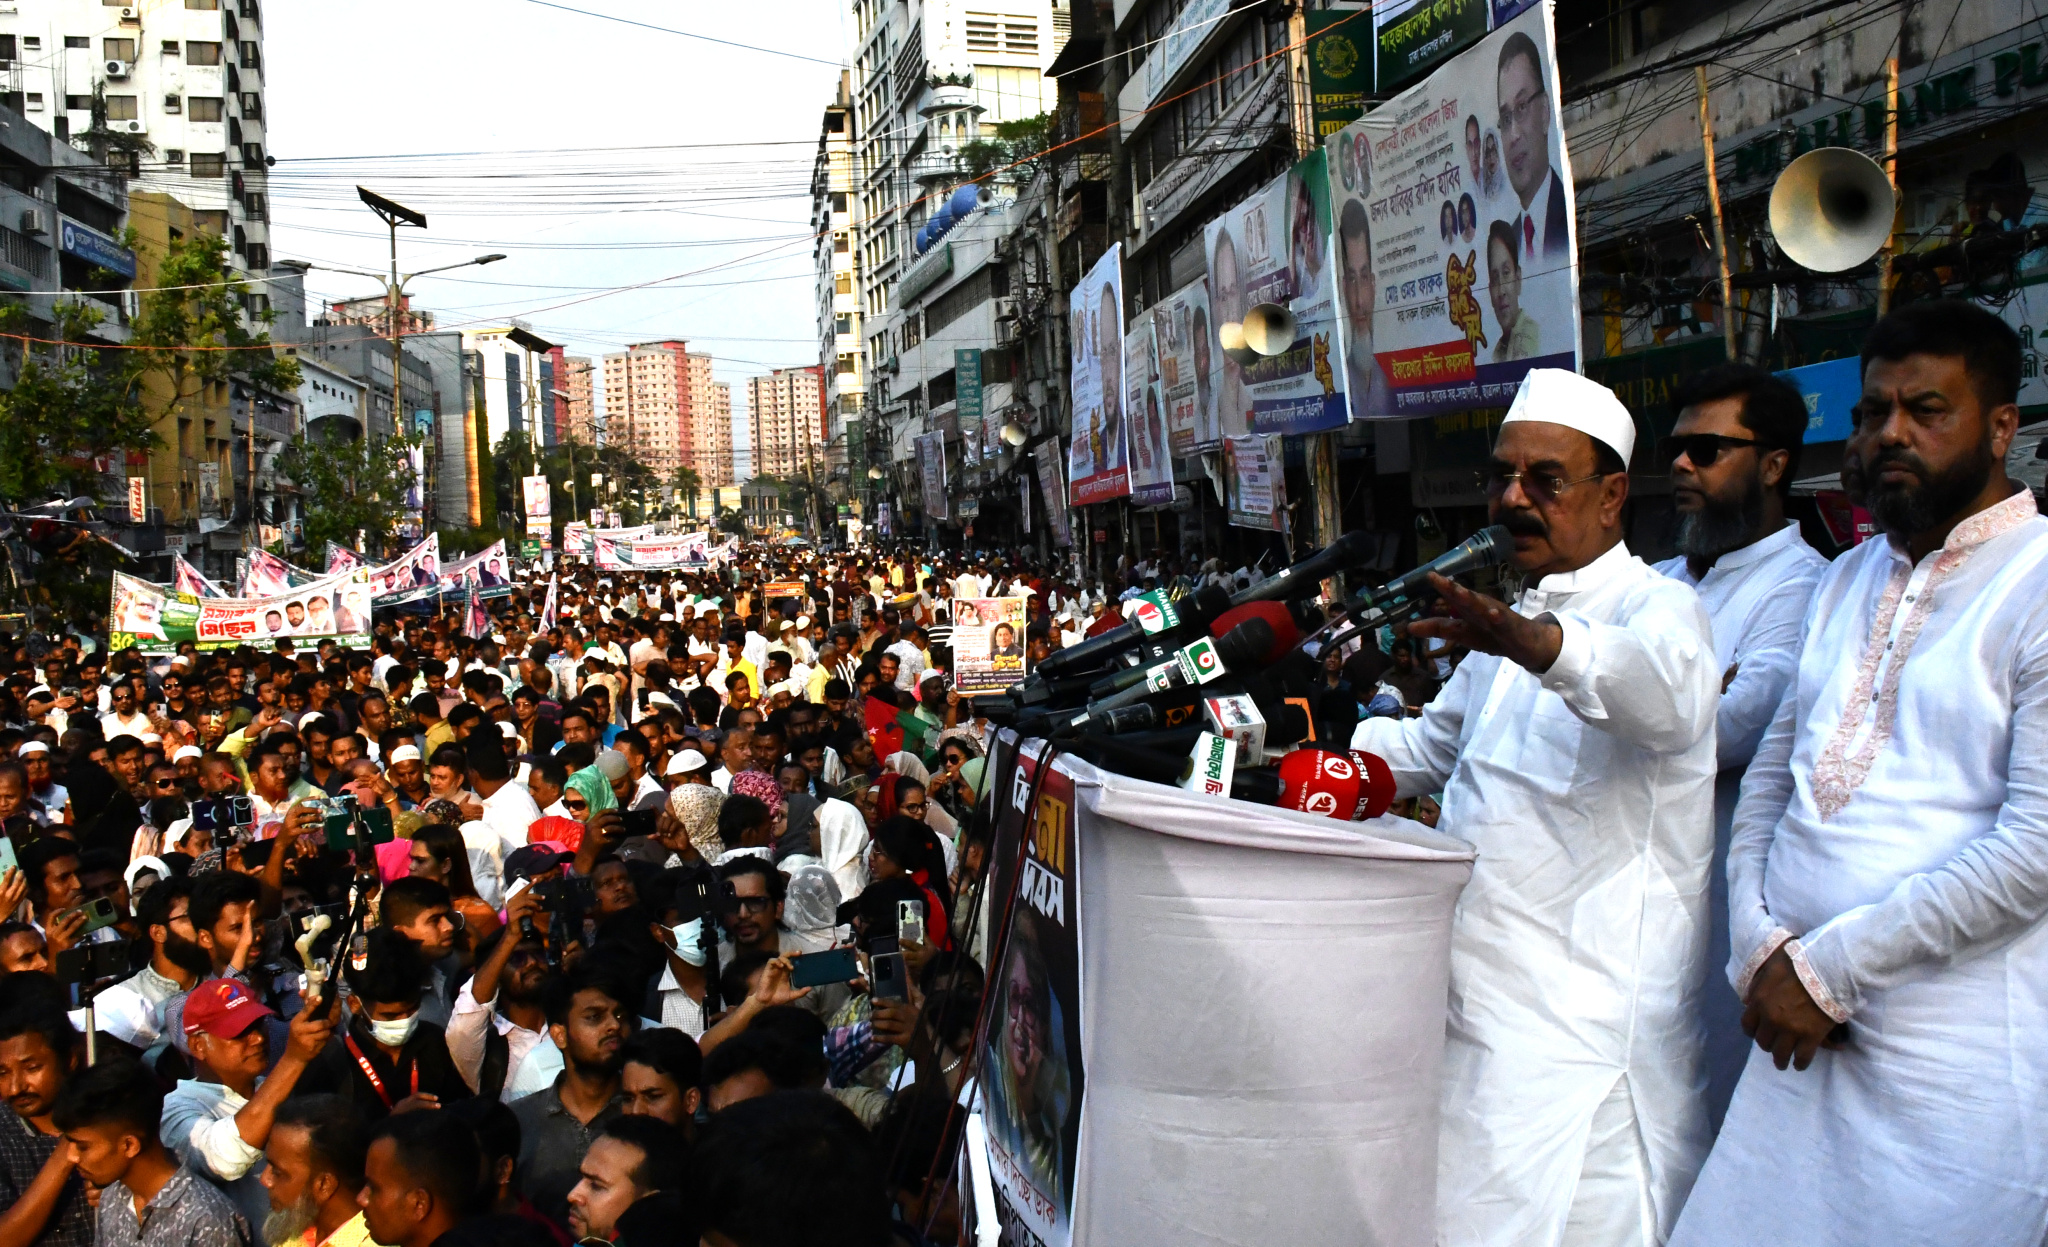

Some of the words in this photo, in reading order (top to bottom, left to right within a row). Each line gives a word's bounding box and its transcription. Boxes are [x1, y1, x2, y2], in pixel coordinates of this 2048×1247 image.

[1990, 41, 2048, 97] PL
[1437, 161, 1461, 196] হাবিব
[1418, 272, 1443, 296] ফারুক
[131, 479, 142, 519] Bata
[203, 607, 257, 620] সমাবেশ
[1155, 587, 1179, 627] CHANNEL
[199, 619, 257, 639] মিছিল
[1348, 751, 1369, 781] DESH
[1036, 793, 1068, 876] মা
[358, 1056, 380, 1087] PRESS
